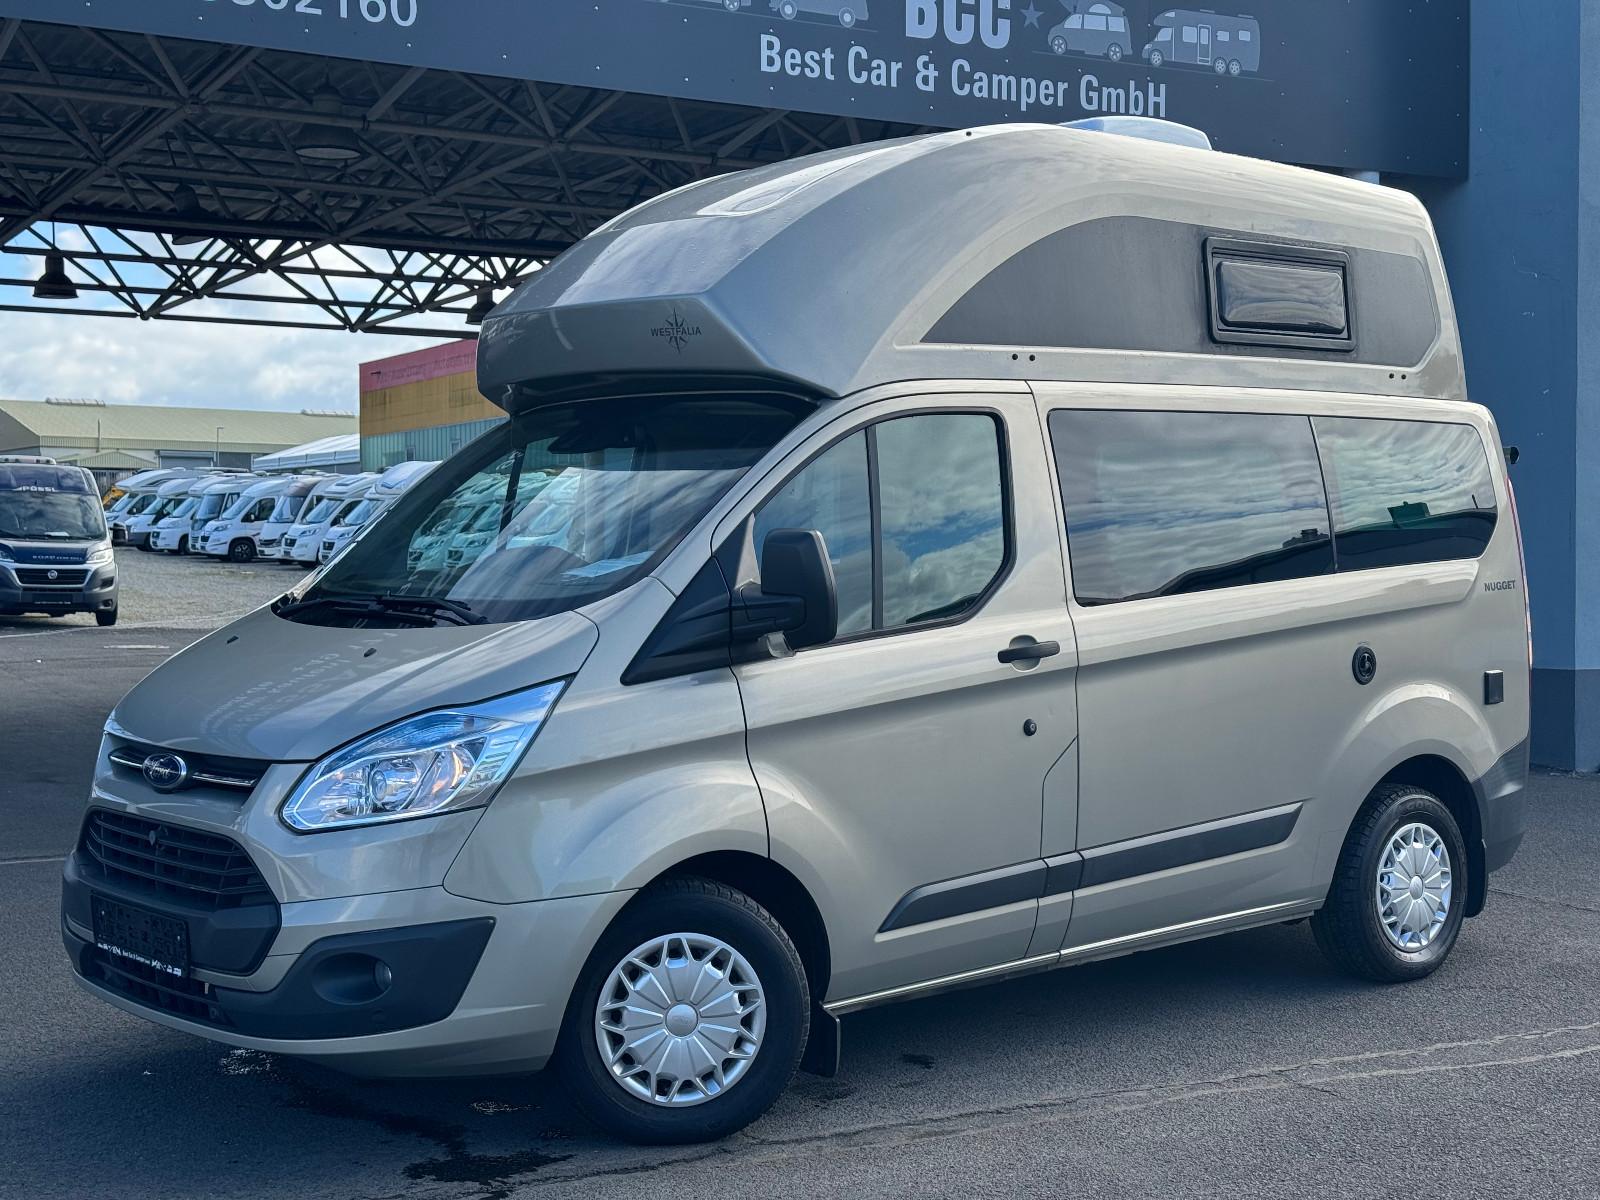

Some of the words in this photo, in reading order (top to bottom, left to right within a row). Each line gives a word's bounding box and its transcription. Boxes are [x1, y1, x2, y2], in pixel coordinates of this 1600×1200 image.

[905, 0, 1011, 49] BCC
[760, 33, 835, 81] Best
[848, 45, 903, 88] Car
[915, 54, 939, 92] &
[951, 58, 1069, 112] Camper
[1079, 74, 1166, 118] GmbH
[650, 326, 702, 337] WESTFALIA
[1484, 580, 1516, 592] NUGGET
